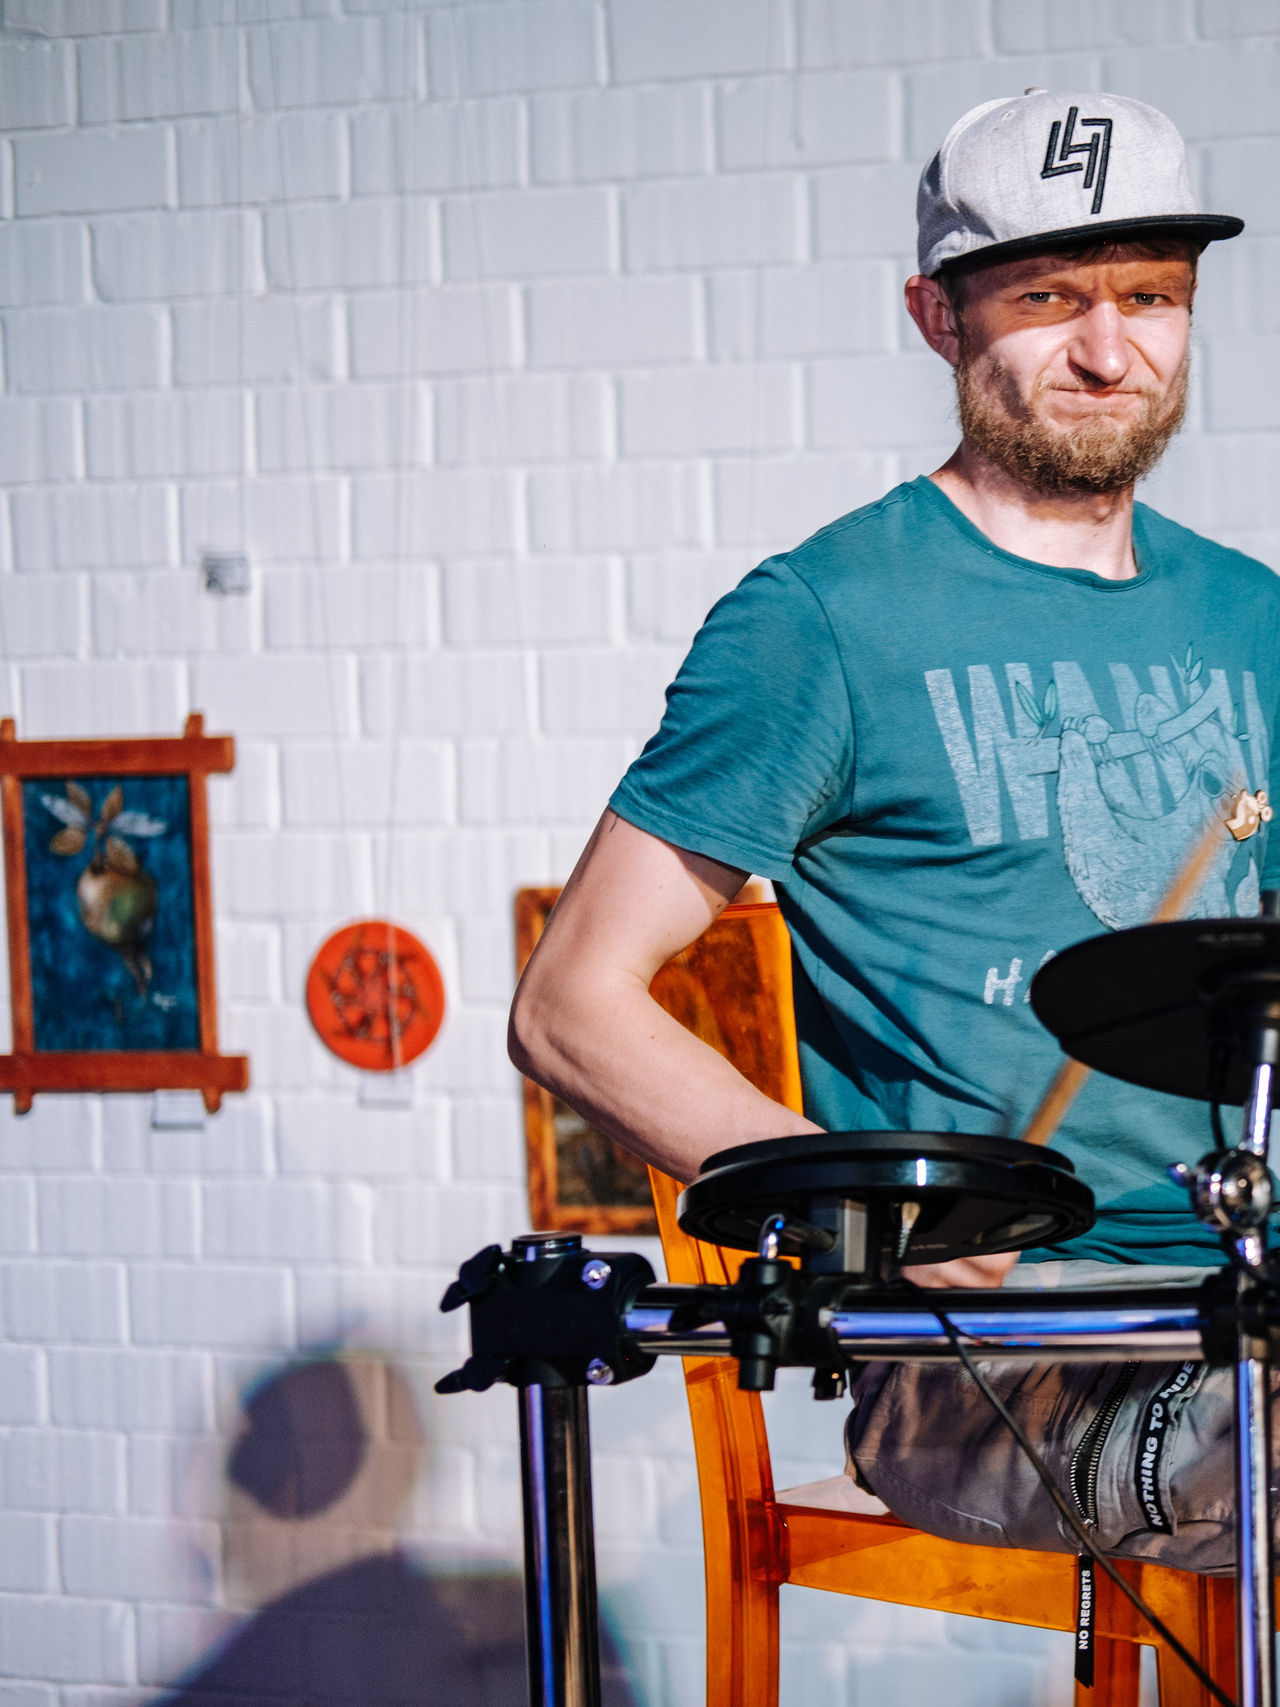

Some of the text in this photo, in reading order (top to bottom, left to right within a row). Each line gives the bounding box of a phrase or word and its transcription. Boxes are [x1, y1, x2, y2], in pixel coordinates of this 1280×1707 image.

[1149, 1402, 1164, 1432] TO
[1140, 1437, 1165, 1527] NOTHING
[1078, 1570, 1092, 1650] NO REGRETS
